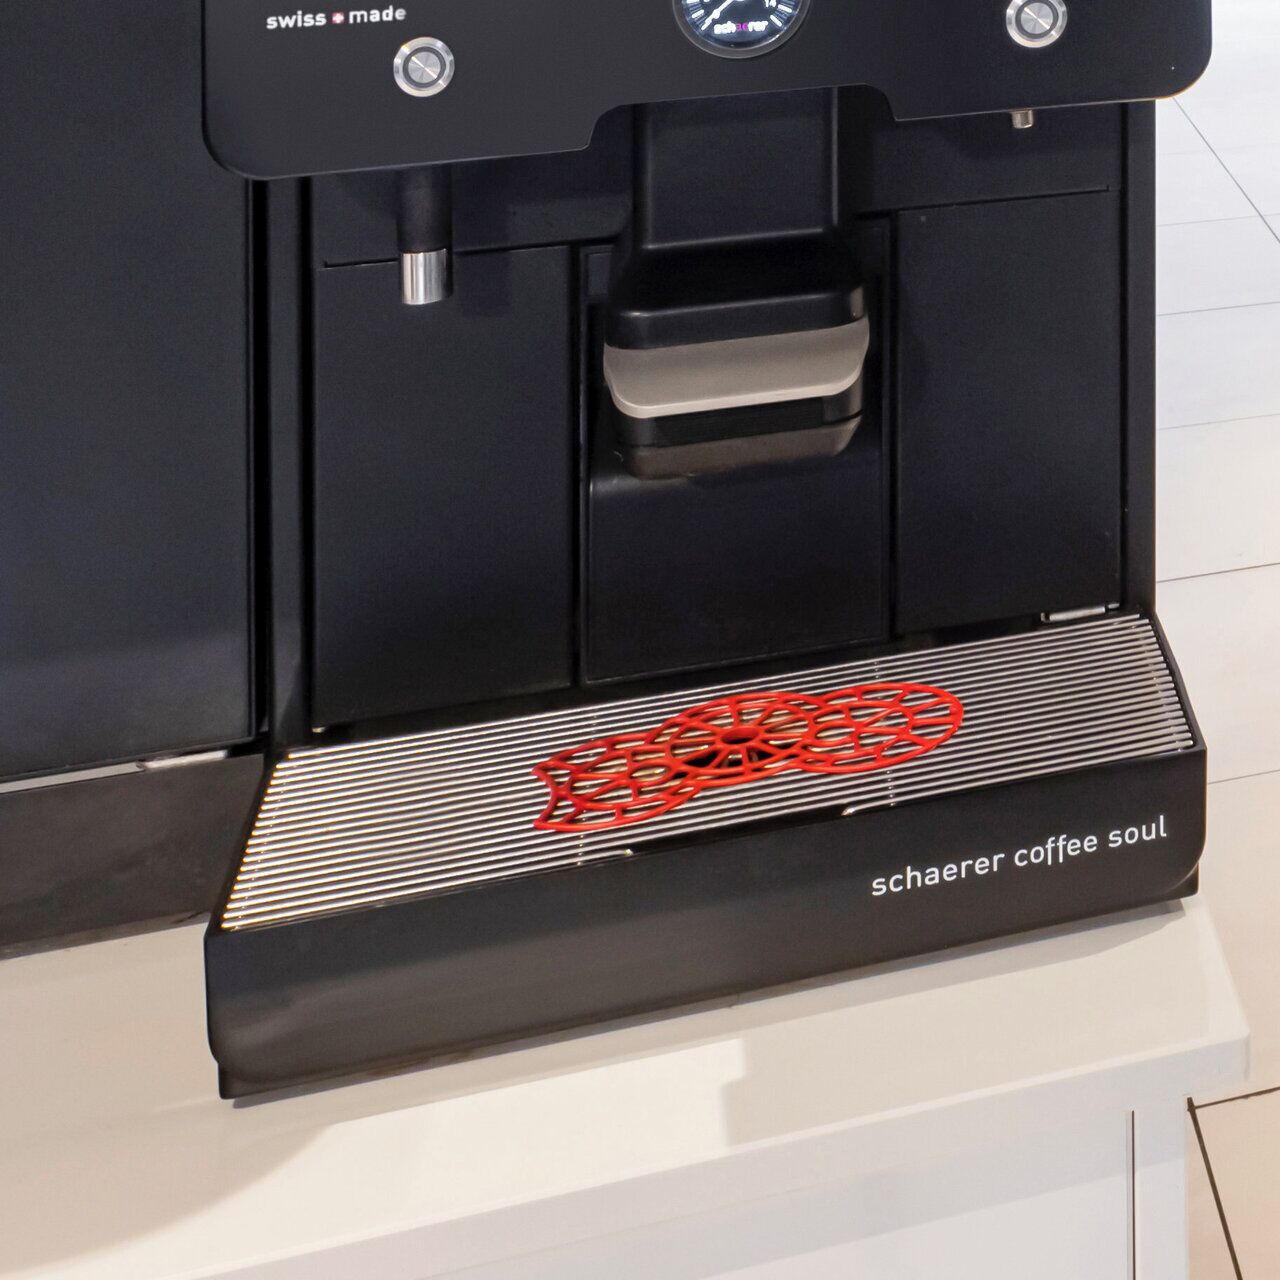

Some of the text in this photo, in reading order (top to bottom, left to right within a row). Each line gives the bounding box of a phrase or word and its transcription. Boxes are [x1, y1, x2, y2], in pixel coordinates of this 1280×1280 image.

[266, 4, 407, 30] swiss made
[713, 20, 769, 35] schaerer
[871, 814, 1167, 897] schaerer coffee soul
